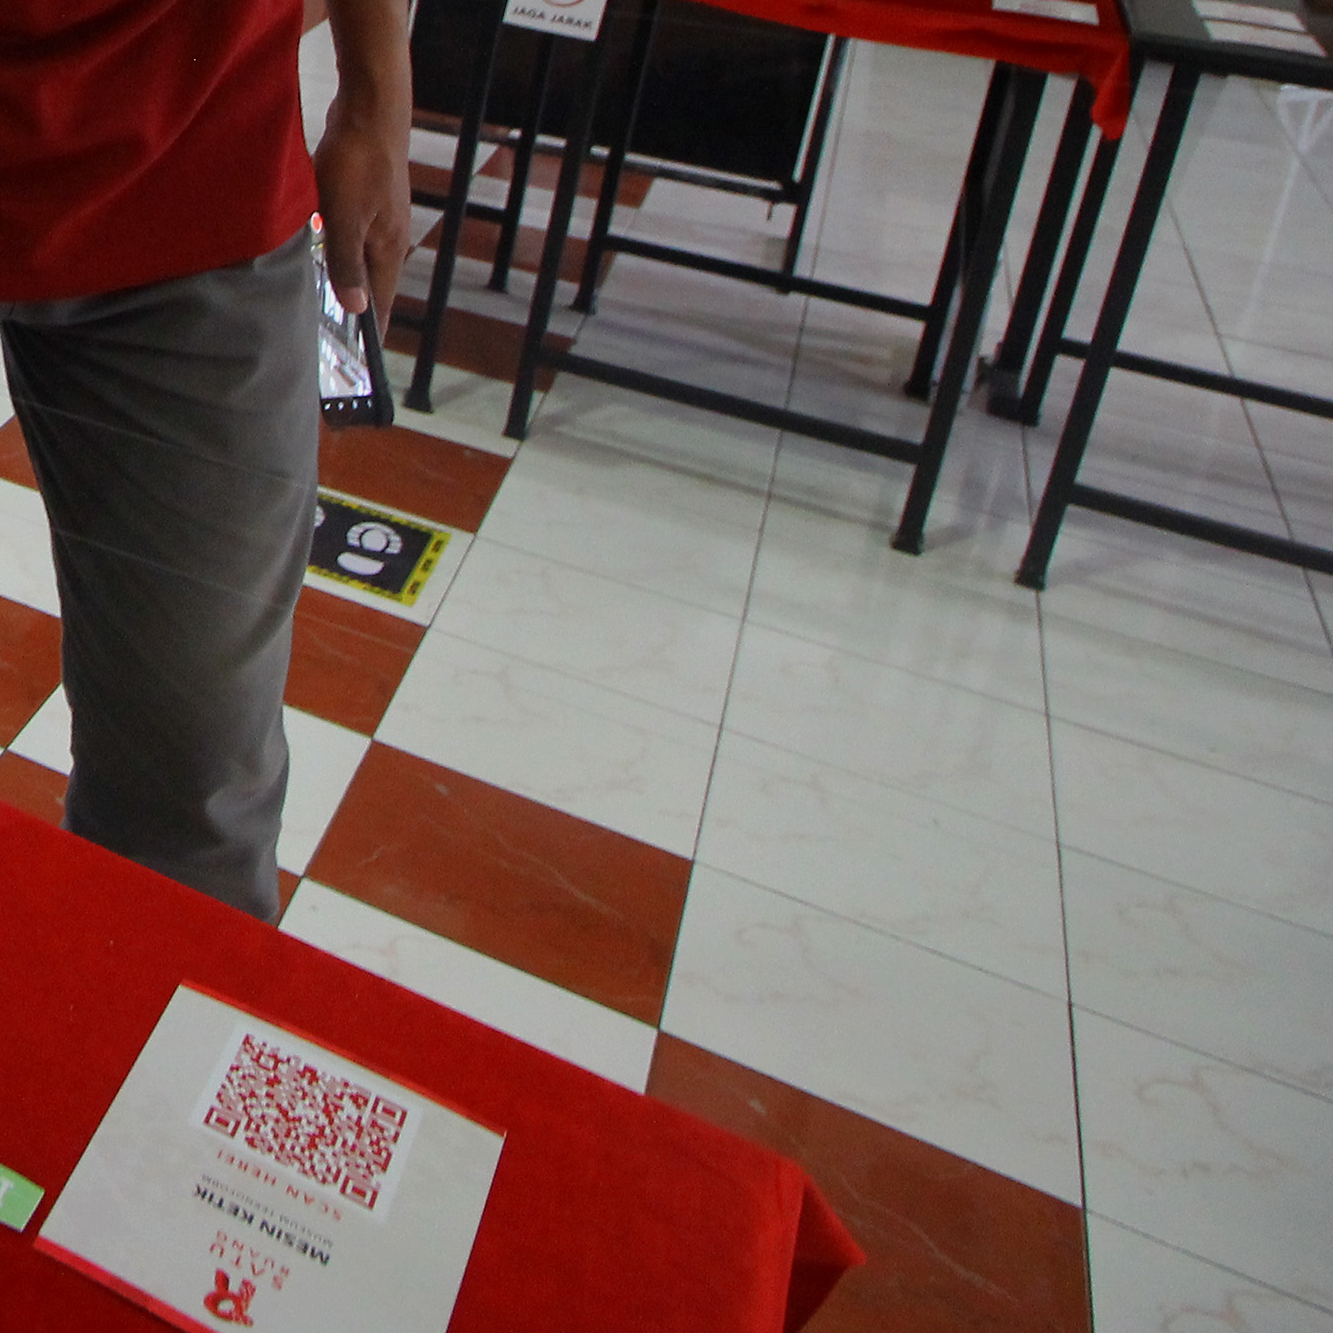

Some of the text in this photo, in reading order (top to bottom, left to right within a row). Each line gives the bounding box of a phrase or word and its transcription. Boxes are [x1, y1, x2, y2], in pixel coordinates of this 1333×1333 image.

[193, 1184, 331, 1267] MESIN KETIK
[285, 1184, 342, 1222] SCAN
[209, 1242, 284, 1291] SATU
[203, 1268, 254, 1327] R
